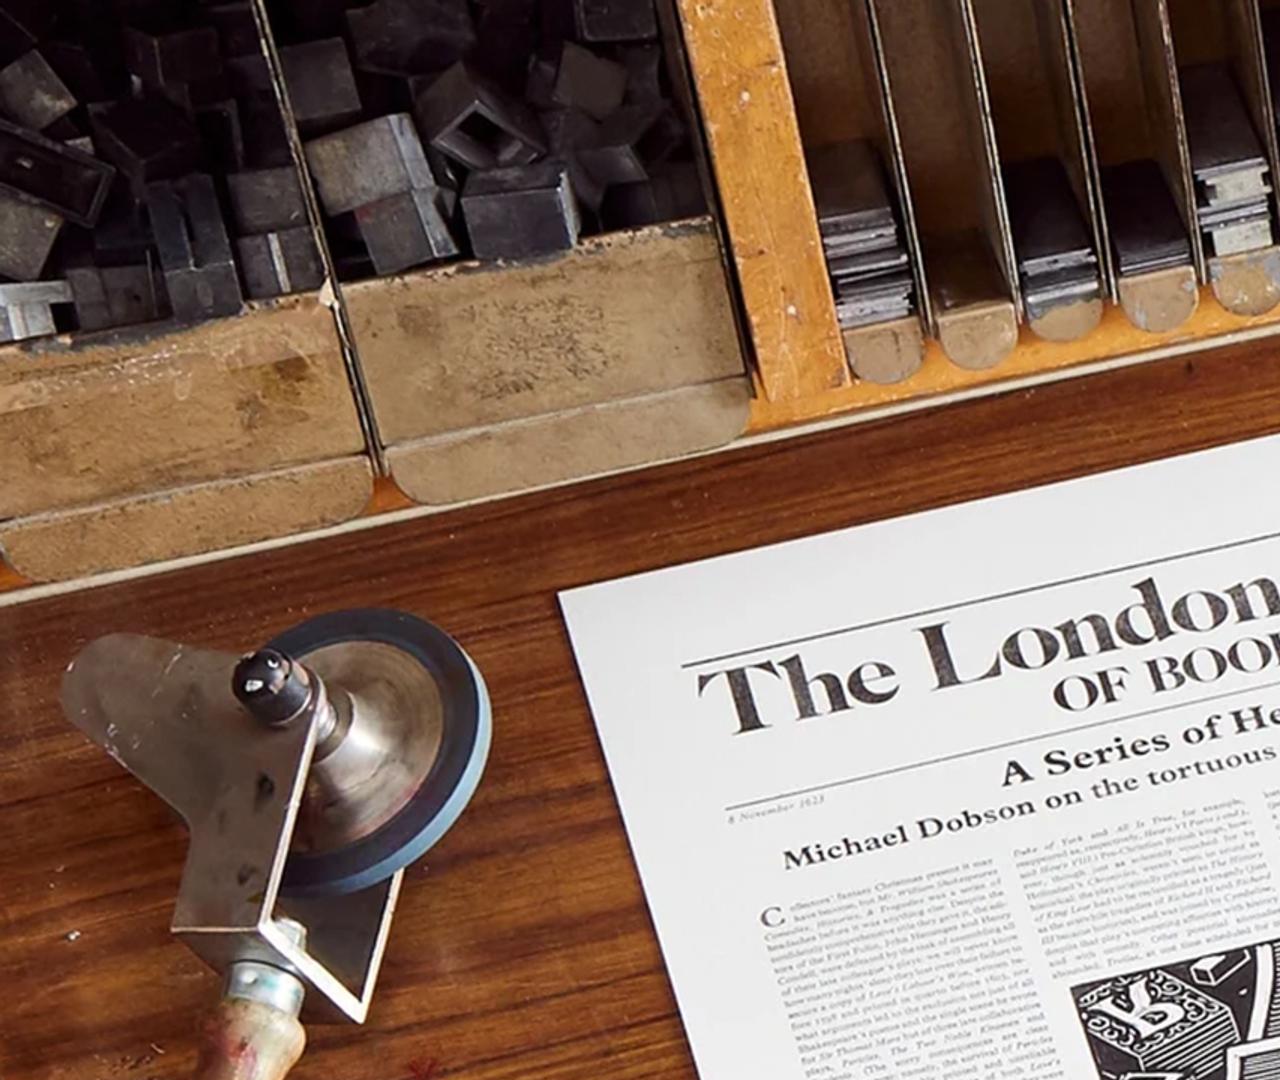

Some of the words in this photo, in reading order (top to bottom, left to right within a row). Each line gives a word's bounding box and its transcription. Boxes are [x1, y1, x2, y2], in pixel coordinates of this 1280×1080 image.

[697, 653, 900, 735] The
[1052, 665, 1130, 712] OF
[1001, 759, 1035, 788] A
[1043, 733, 1171, 776] Series
[1182, 713, 1223, 745] of
[738, 799, 796, 823] November
[782, 824, 910, 871] Michael
[915, 800, 1037, 840] Dobson
[1044, 790, 1084, 810] on
[1090, 777, 1140, 799] the
[1146, 746, 1278, 786] tortuous
[1060, 834, 1084, 848] York
[873, 874, 924, 893] Christmas
[925, 865, 961, 882] present
